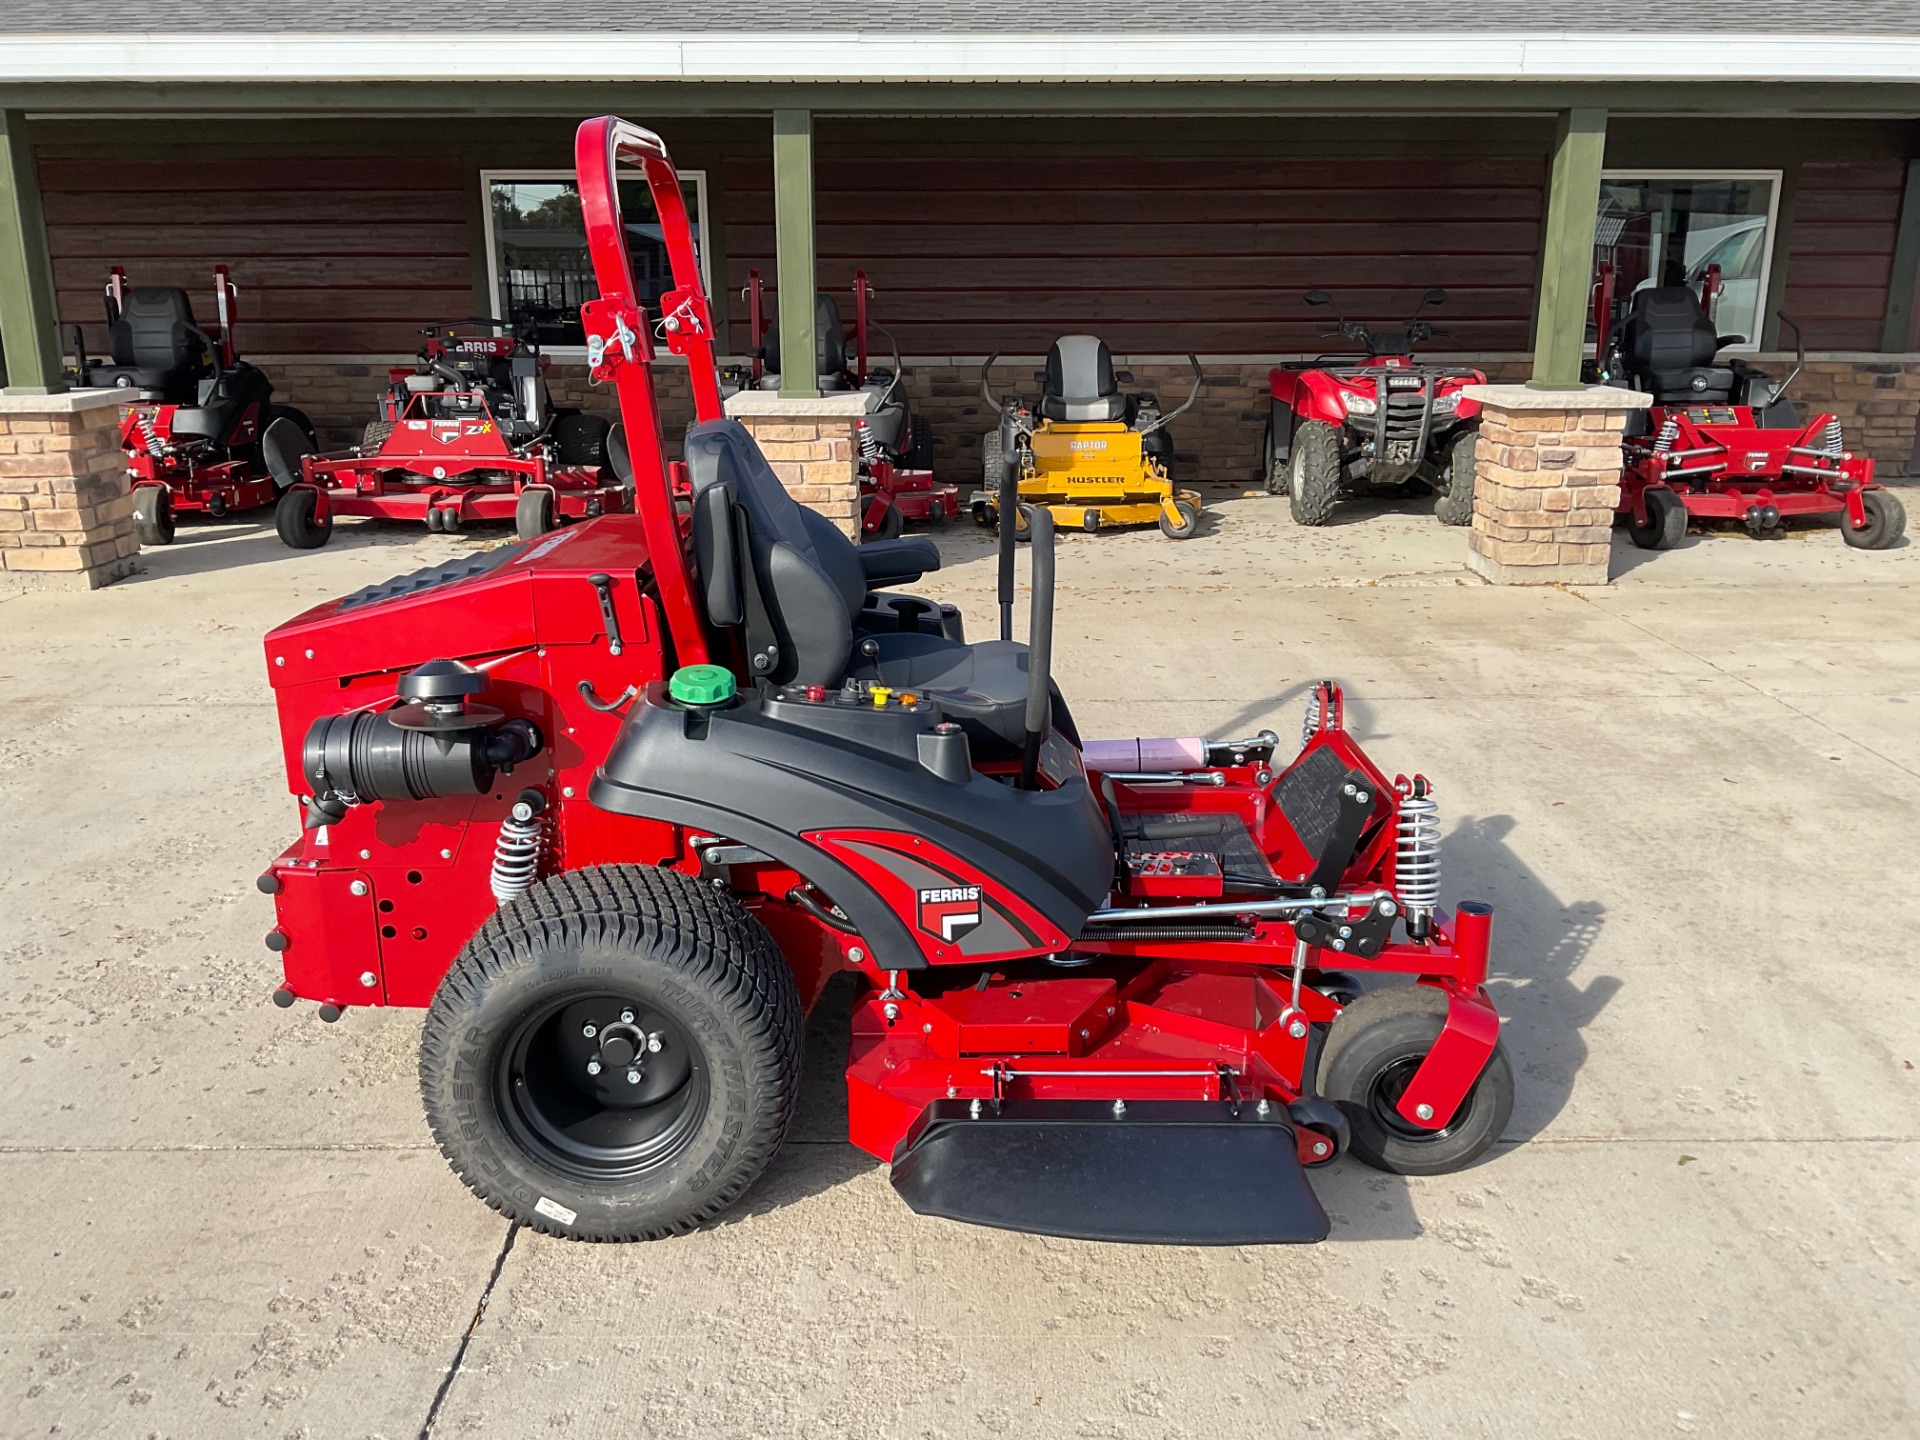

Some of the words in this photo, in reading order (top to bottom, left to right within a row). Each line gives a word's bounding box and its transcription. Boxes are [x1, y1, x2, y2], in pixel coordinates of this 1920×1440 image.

[447, 341, 497, 352] ERRIS
[1070, 441, 1107, 450] RAPTOR
[1067, 476, 1125, 484] HUSTLER
[921, 887, 979, 903] FERRIS
[660, 978, 735, 1049] TURF
[453, 1025, 506, 1178] CARLSTAR
[686, 1058, 746, 1193] MASTER
